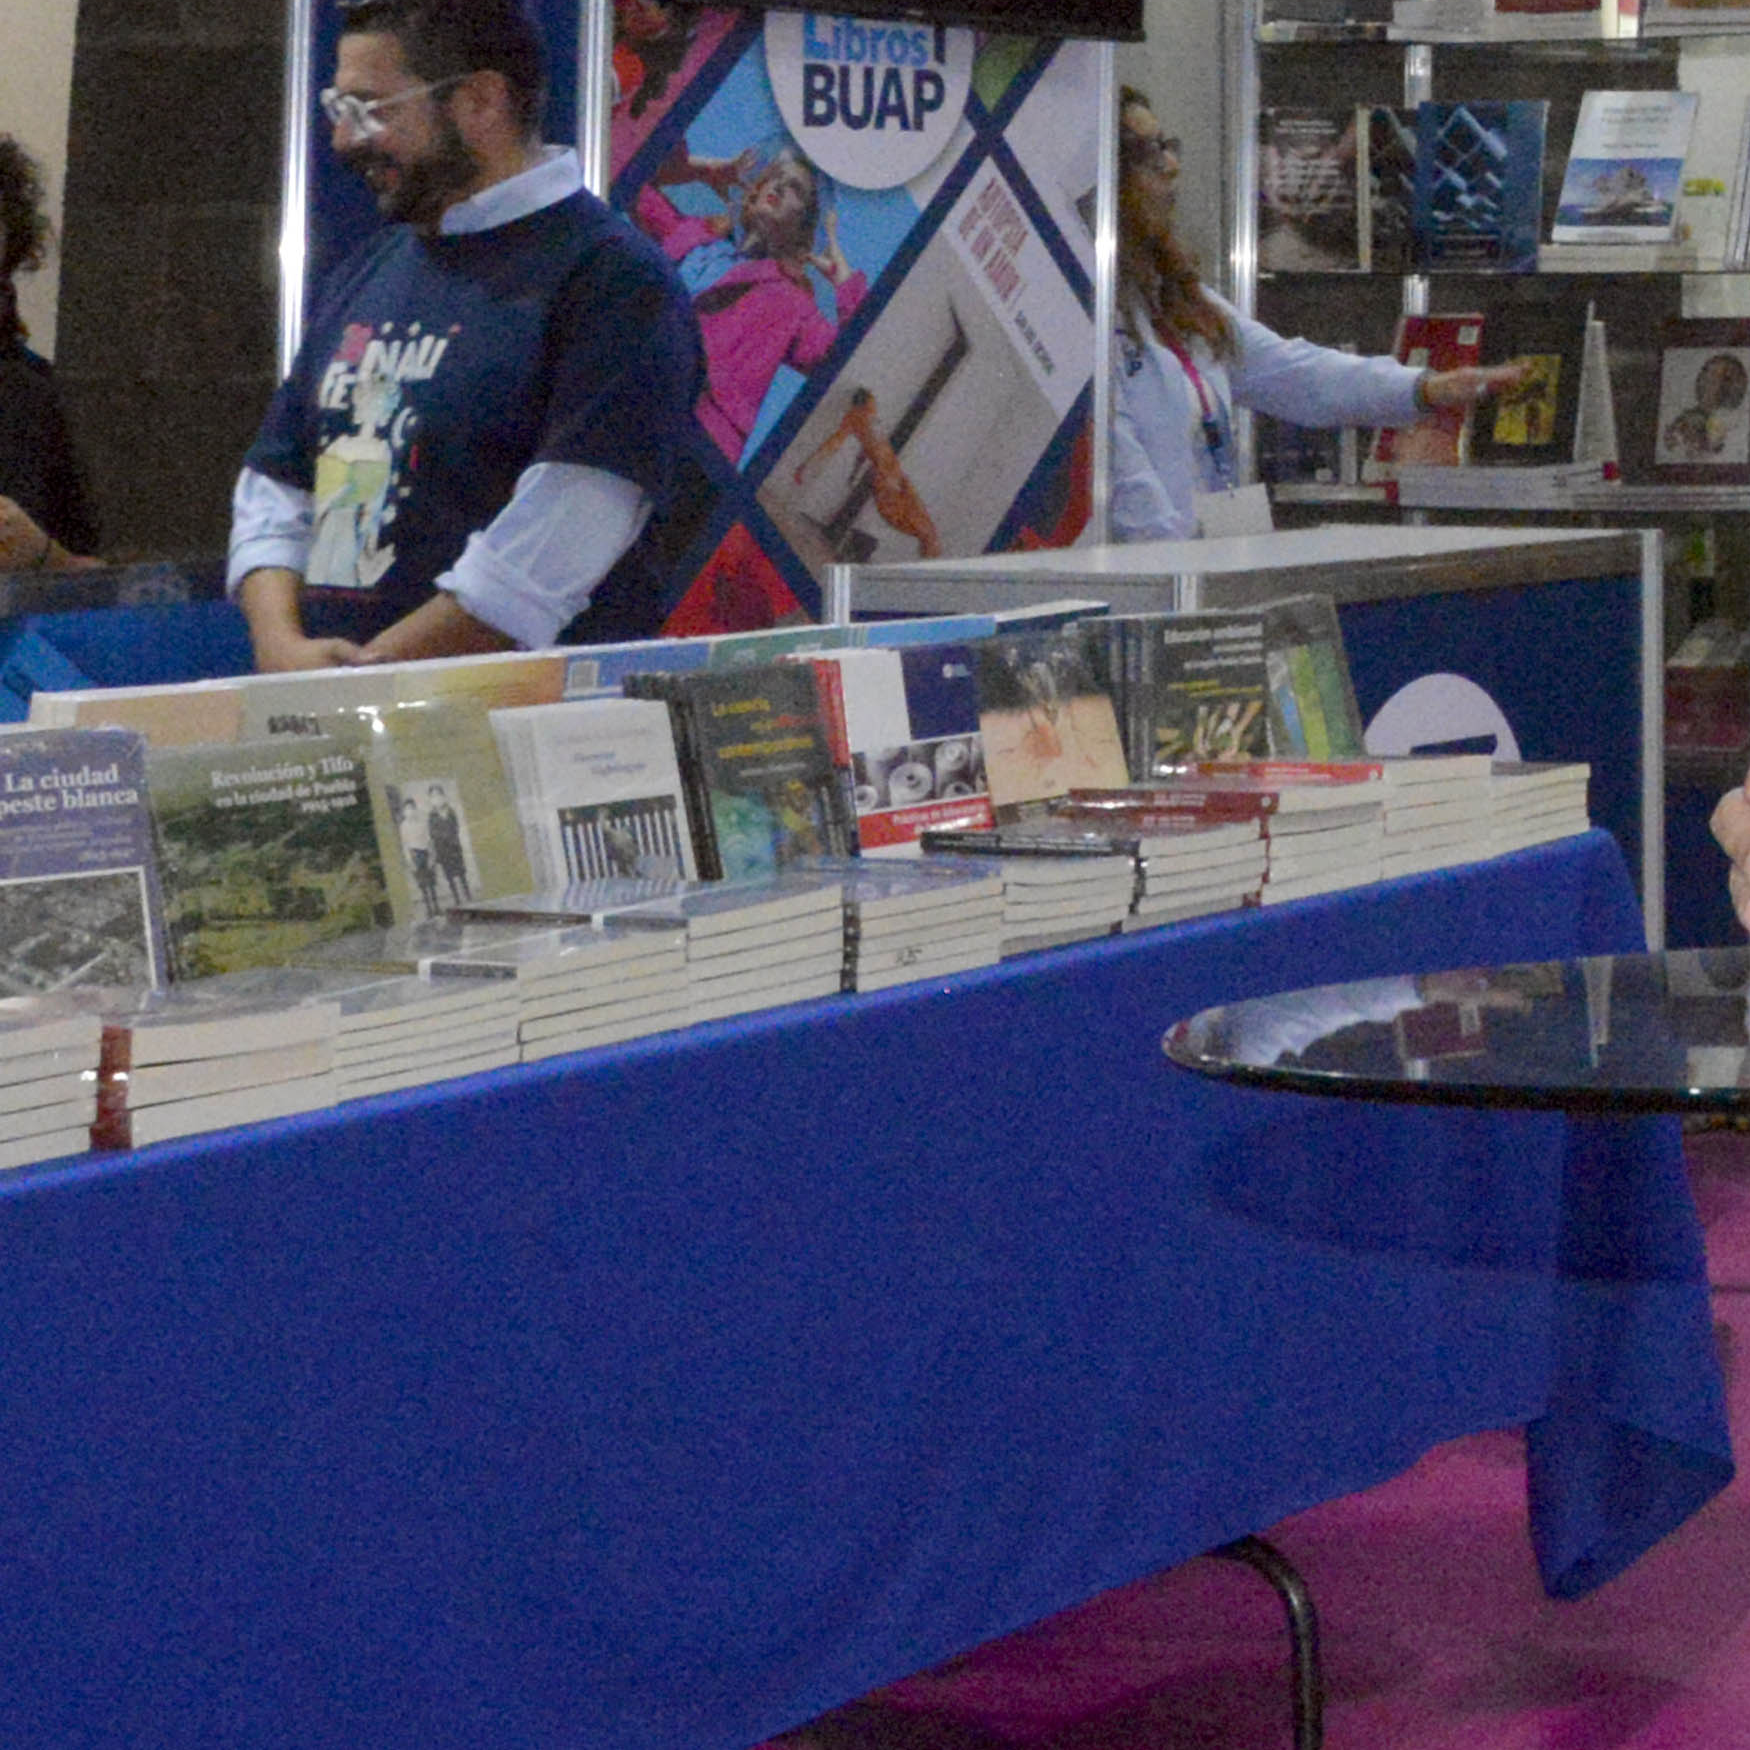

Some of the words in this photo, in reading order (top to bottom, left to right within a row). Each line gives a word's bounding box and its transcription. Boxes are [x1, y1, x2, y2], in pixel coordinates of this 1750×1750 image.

[803, 12, 929, 70] Libros
[803, 63, 946, 132] BUAP
[5, 772, 35, 793] La
[40, 763, 119, 790] ciudad
[211, 761, 305, 790] Revolución
[320, 755, 355, 776] Tifo
[61, 788, 139, 810] blanca
